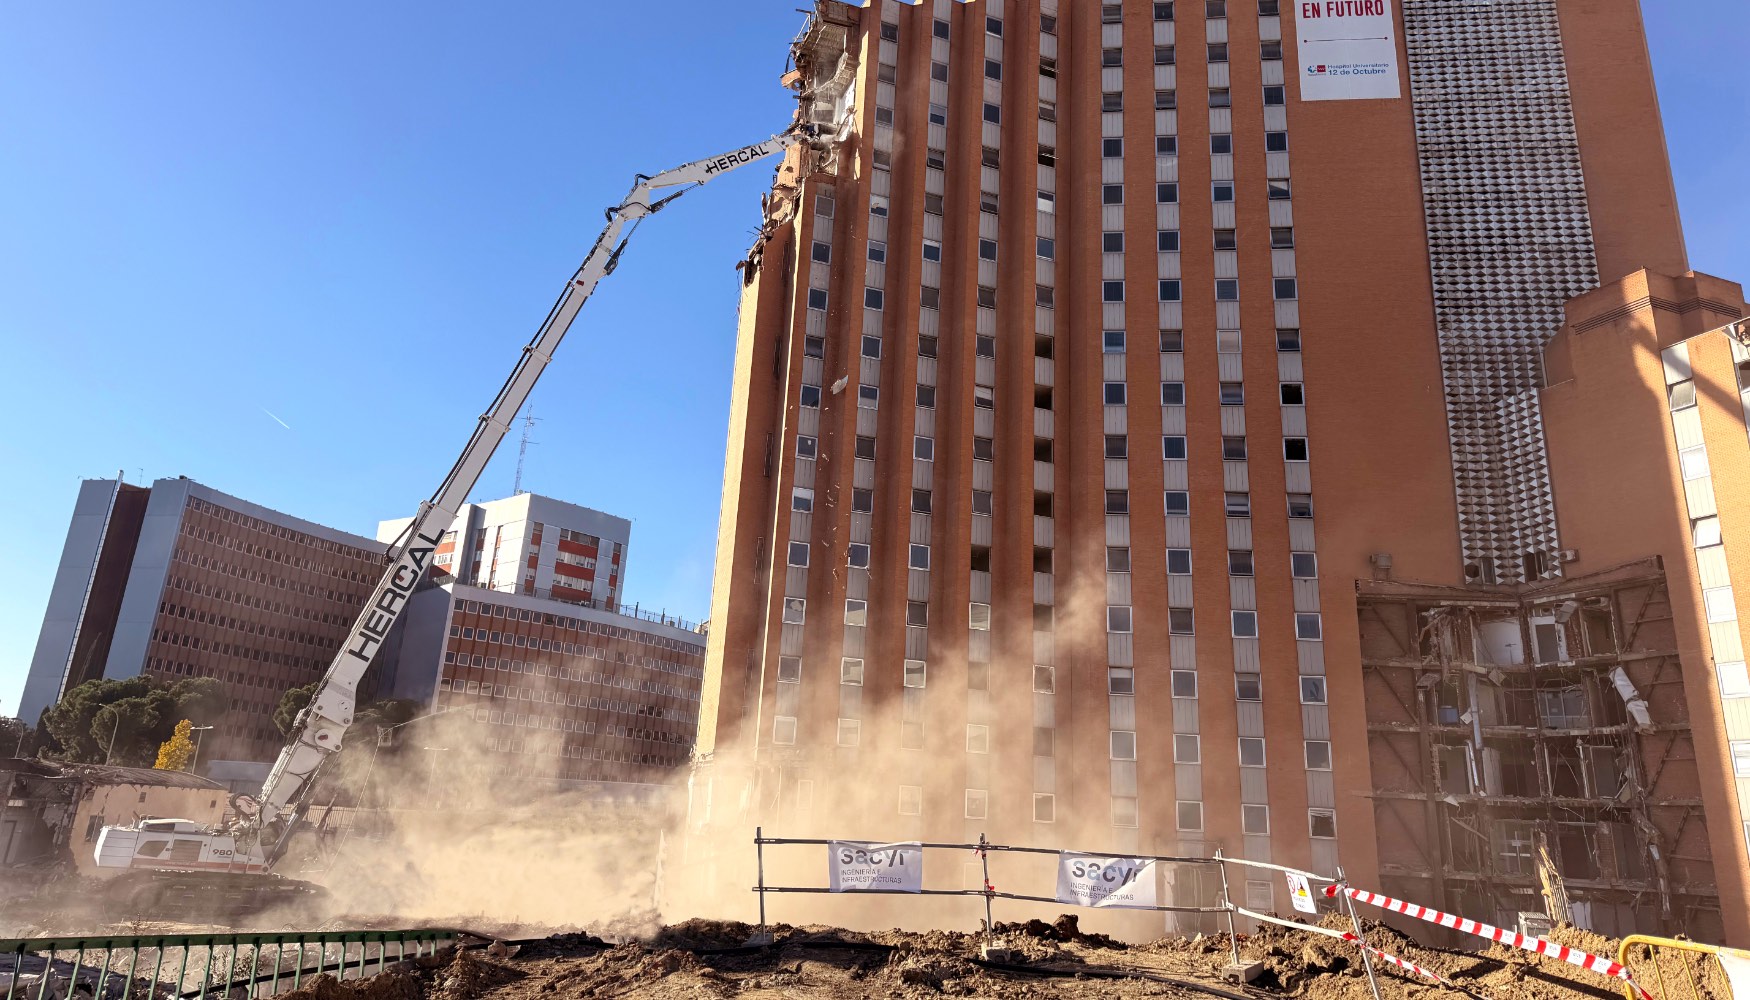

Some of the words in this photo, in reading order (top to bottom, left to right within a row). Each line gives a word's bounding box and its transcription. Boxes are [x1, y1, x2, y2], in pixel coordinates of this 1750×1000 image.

[1302, 2, 1321, 18] EN
[1326, 0, 1384, 17] FUTURO
[706, 145, 769, 174] HERCAL
[348, 528, 446, 663] HERCAL
[212, 848, 233, 857] 980
[840, 848, 909, 868] sacyr
[877, 868, 881, 876] E
[1069, 889, 1134, 901] INFRAESTRUCTURAS
